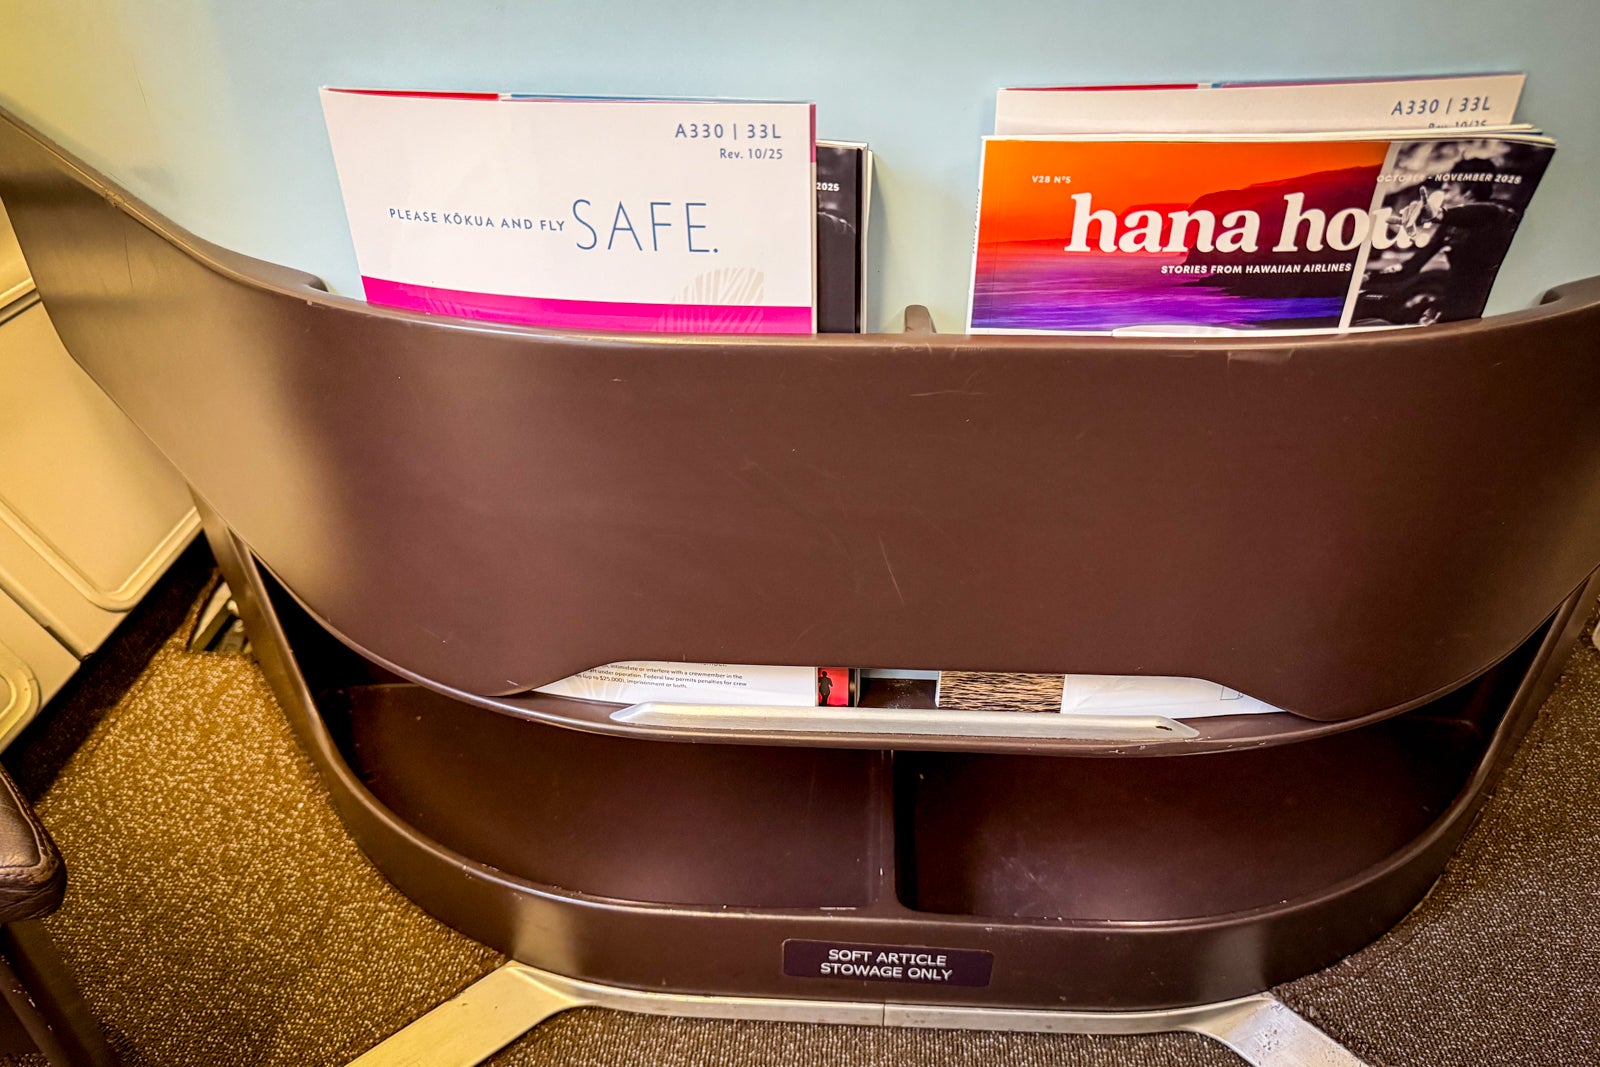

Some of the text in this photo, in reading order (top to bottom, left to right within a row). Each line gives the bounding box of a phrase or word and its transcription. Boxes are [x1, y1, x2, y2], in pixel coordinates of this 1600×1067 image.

[1391, 99, 1439, 115] A330
[1459, 96, 1490, 112] 33L
[675, 123, 724, 138] A330
[747, 124, 782, 139] 33L
[720, 148, 783, 159] Rev. 10/25
[1031, 175, 1051, 184] V28
[1434, 173, 1493, 182] NOVEMBER
[1493, 174, 1522, 184] 2025
[816, 182, 840, 192] 2025
[389, 199, 719, 253] PLEASE KŌKUA AND FLY SAFE.
[1064, 192, 1260, 253] hana
[1161, 263, 1352, 274] STORIES FROM HAWAIIAN AIRLINES
[689, 671, 725, 679] crewmember
[828, 949, 947, 967] SOFT ARTICLE
[820, 962, 953, 982] STOWAGE ONLY
